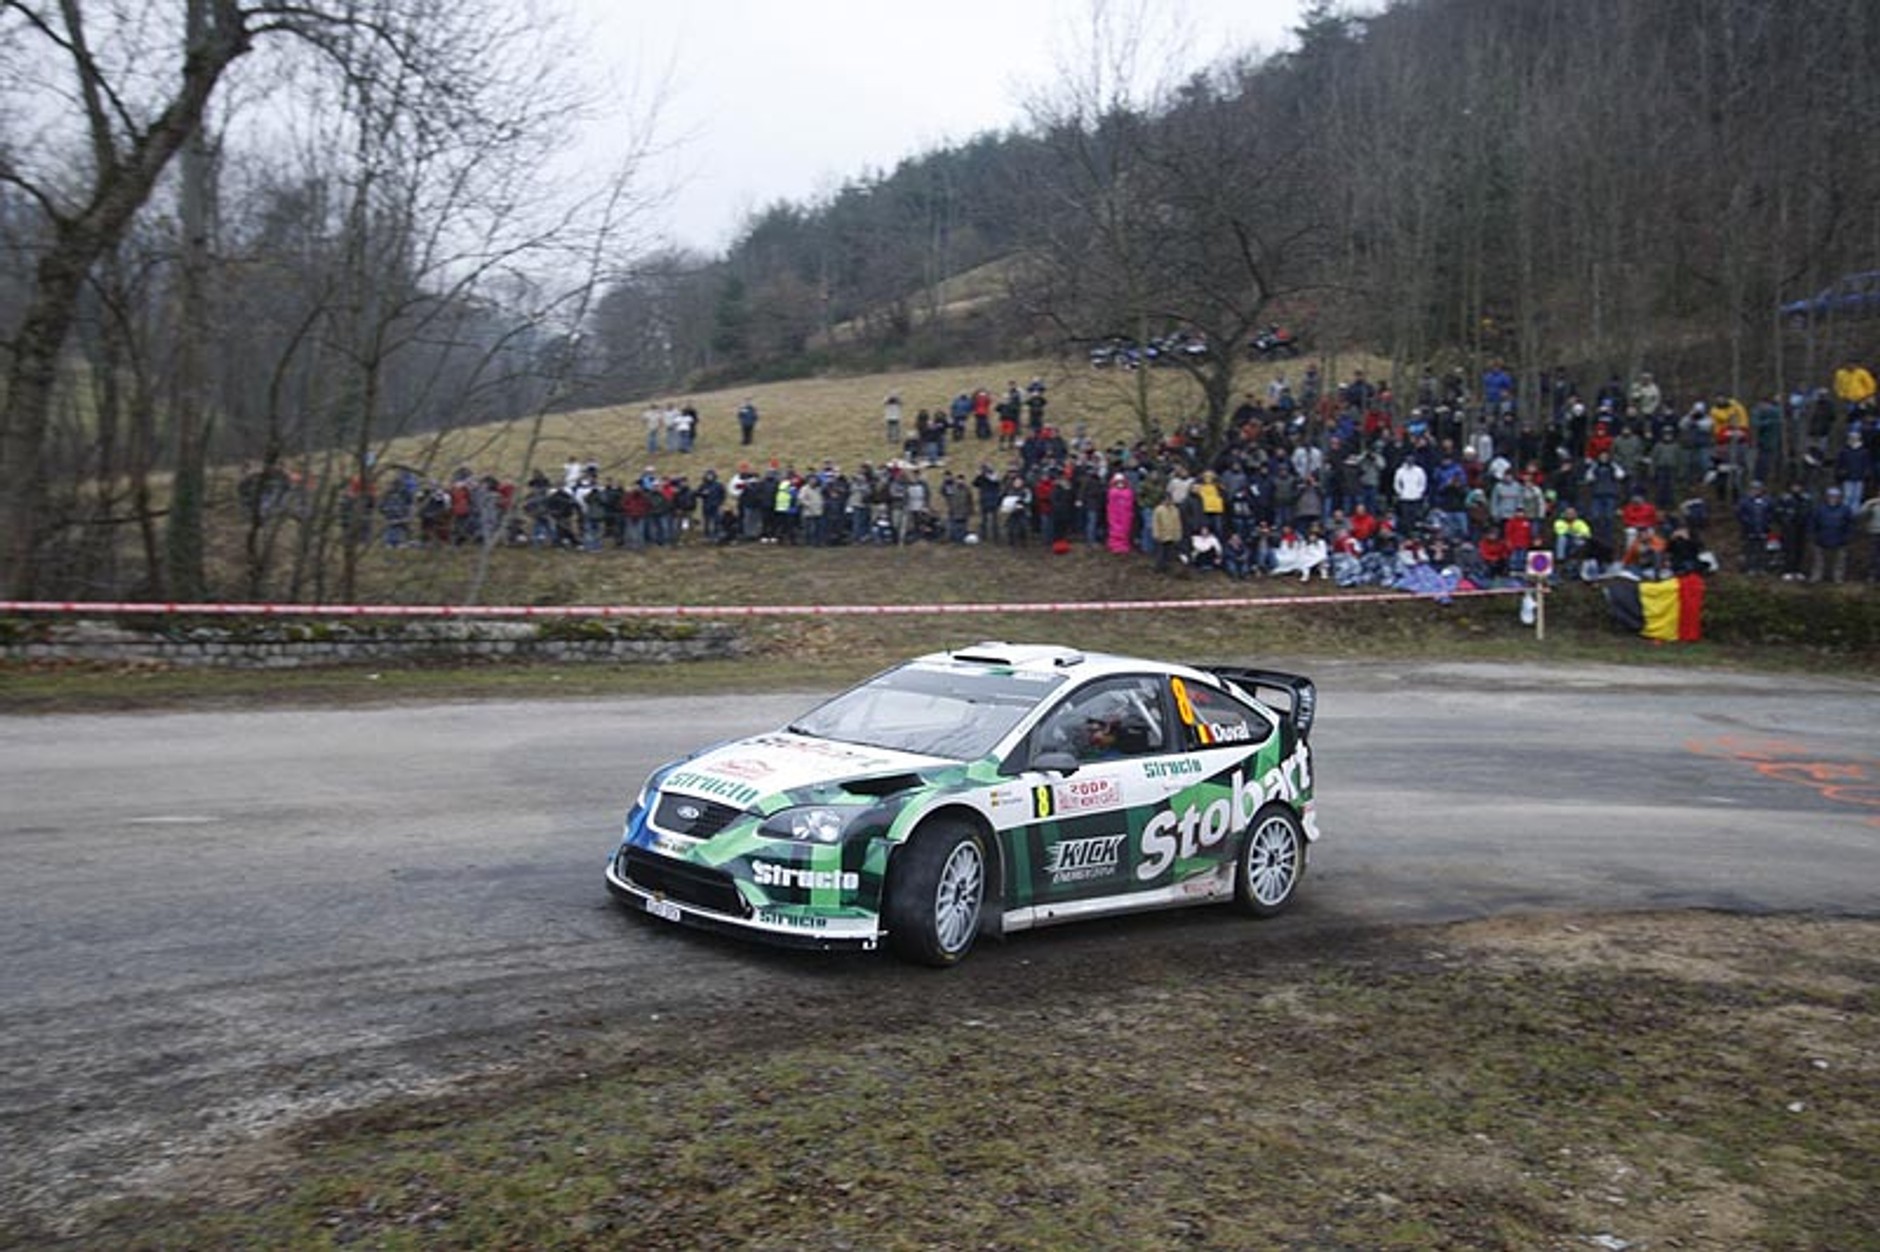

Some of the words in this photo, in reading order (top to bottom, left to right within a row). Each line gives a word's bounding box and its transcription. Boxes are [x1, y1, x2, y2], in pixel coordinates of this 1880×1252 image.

[1170, 675, 1195, 726] 8
[1212, 720, 1250, 743] Duval
[1036, 785, 1050, 818] 8
[1137, 738, 1311, 881] Stobart
[751, 859, 860, 890] Structo
